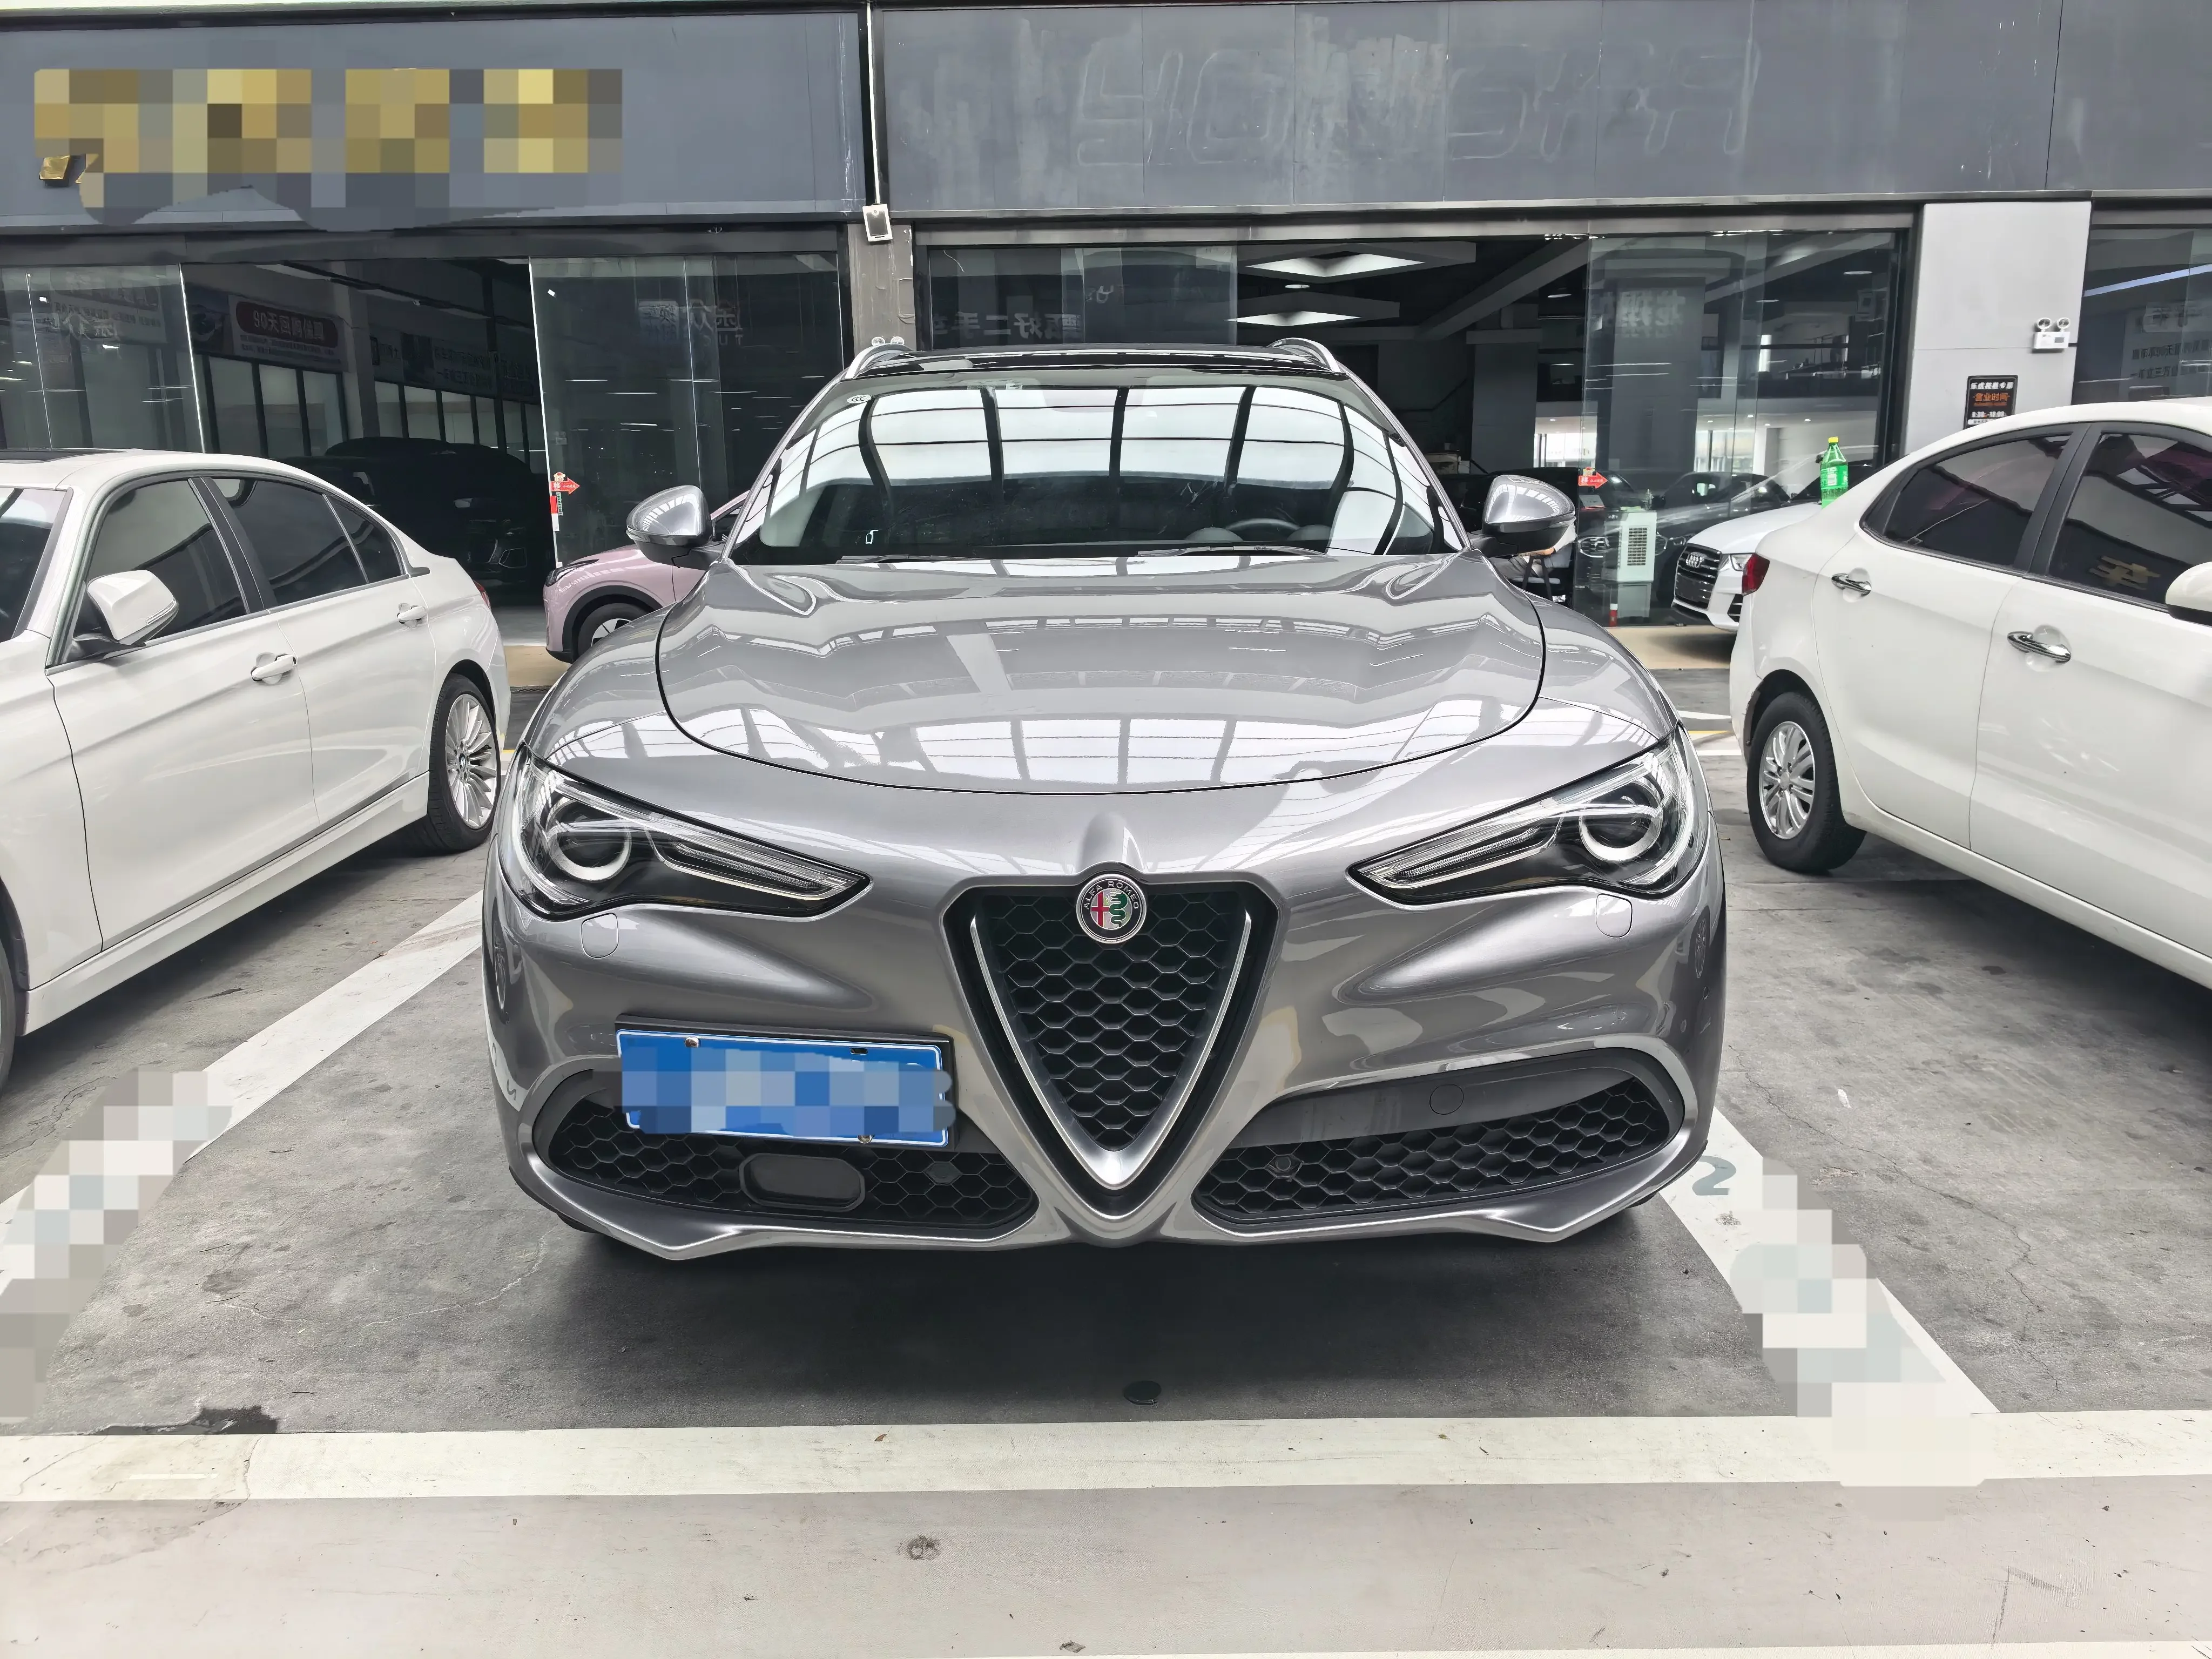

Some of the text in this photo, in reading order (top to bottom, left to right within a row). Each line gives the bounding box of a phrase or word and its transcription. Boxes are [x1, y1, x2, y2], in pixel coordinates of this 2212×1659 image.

[1083, 881, 1139, 910] ALFA ROMEO
[1691, 1155, 1737, 1196] 2
